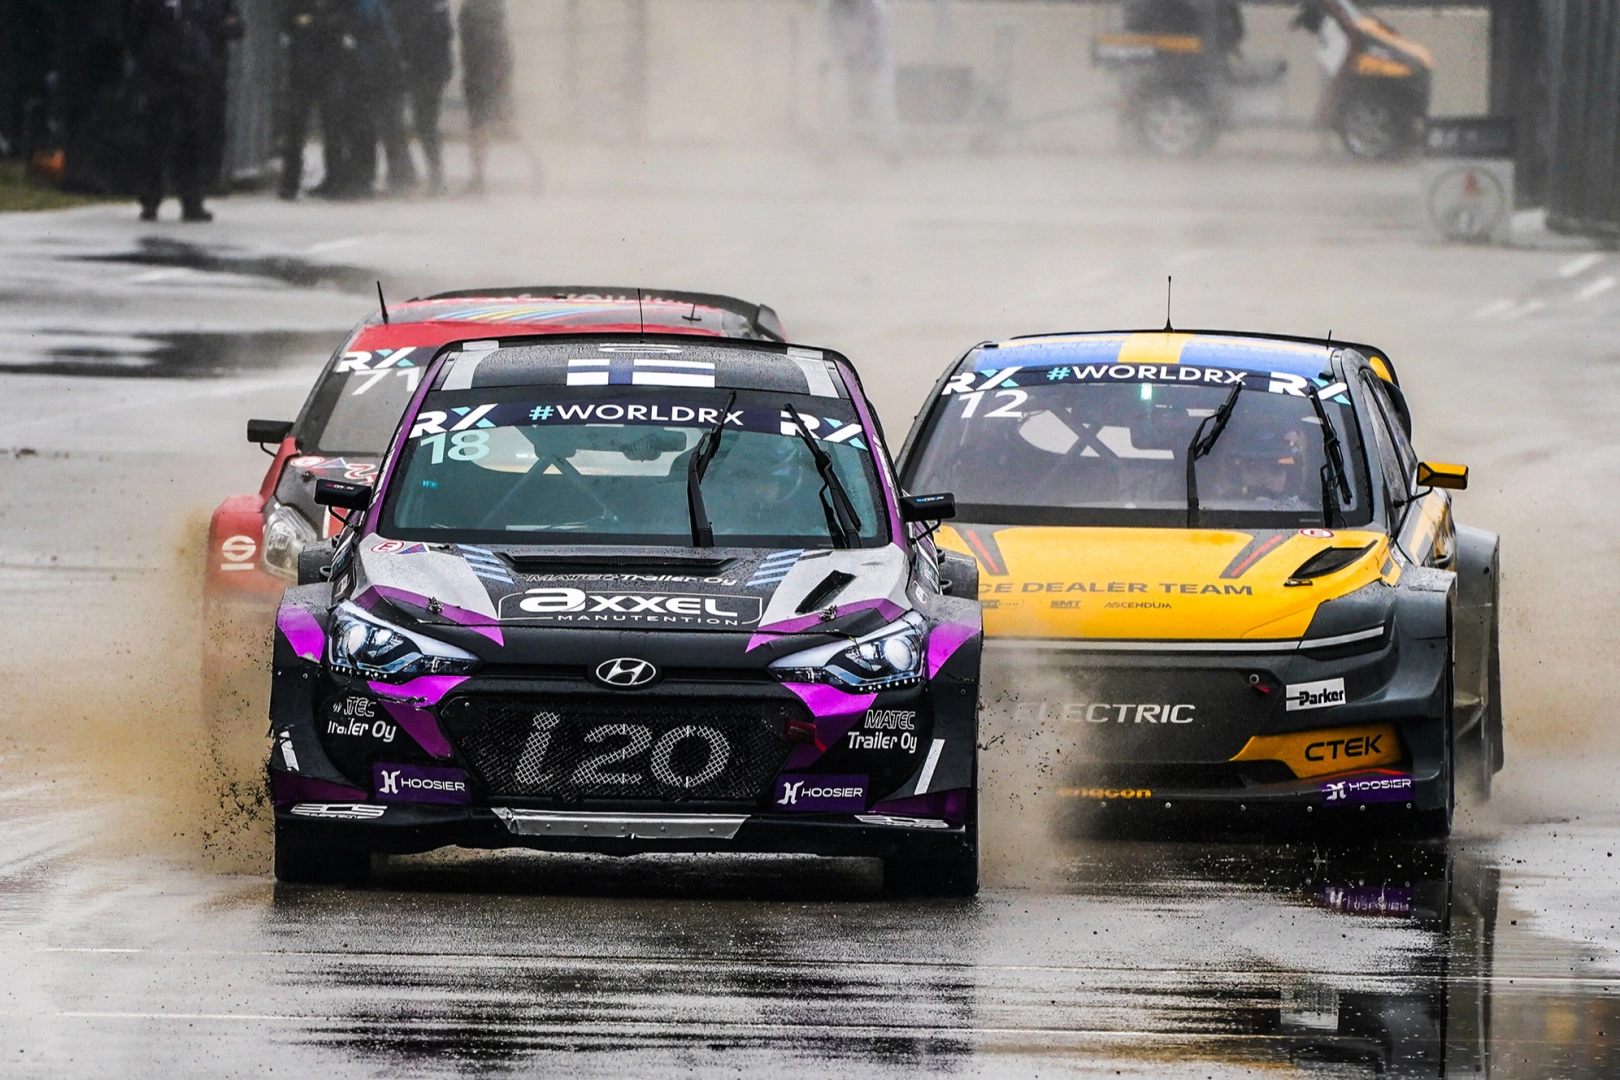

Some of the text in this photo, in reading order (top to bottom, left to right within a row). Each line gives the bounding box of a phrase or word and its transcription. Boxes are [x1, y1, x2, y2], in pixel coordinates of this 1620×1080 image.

[351, 366, 420, 396] 71
[1046, 364, 1248, 386] #WORLDRX
[528, 403, 744, 426] #WORLDRX
[958, 389, 1028, 419] 12
[420, 429, 490, 464] 18
[1021, 582, 1149, 594] DEALER
[1158, 582, 1254, 596] TEAM
[1103, 601, 1173, 609] ASCENDUM
[557, 614, 739, 627] MANUTENTION
[1298, 687, 1345, 707] Parker
[864, 709, 916, 730] MATEC
[371, 719, 397, 743] Oy
[847, 730, 918, 754] Trailer Oy
[1304, 733, 1383, 762] CTEK
[400, 777, 466, 792] HOOSIER
[801, 786, 863, 799] HOOSIER
[1348, 778, 1412, 792] HOOSIER
